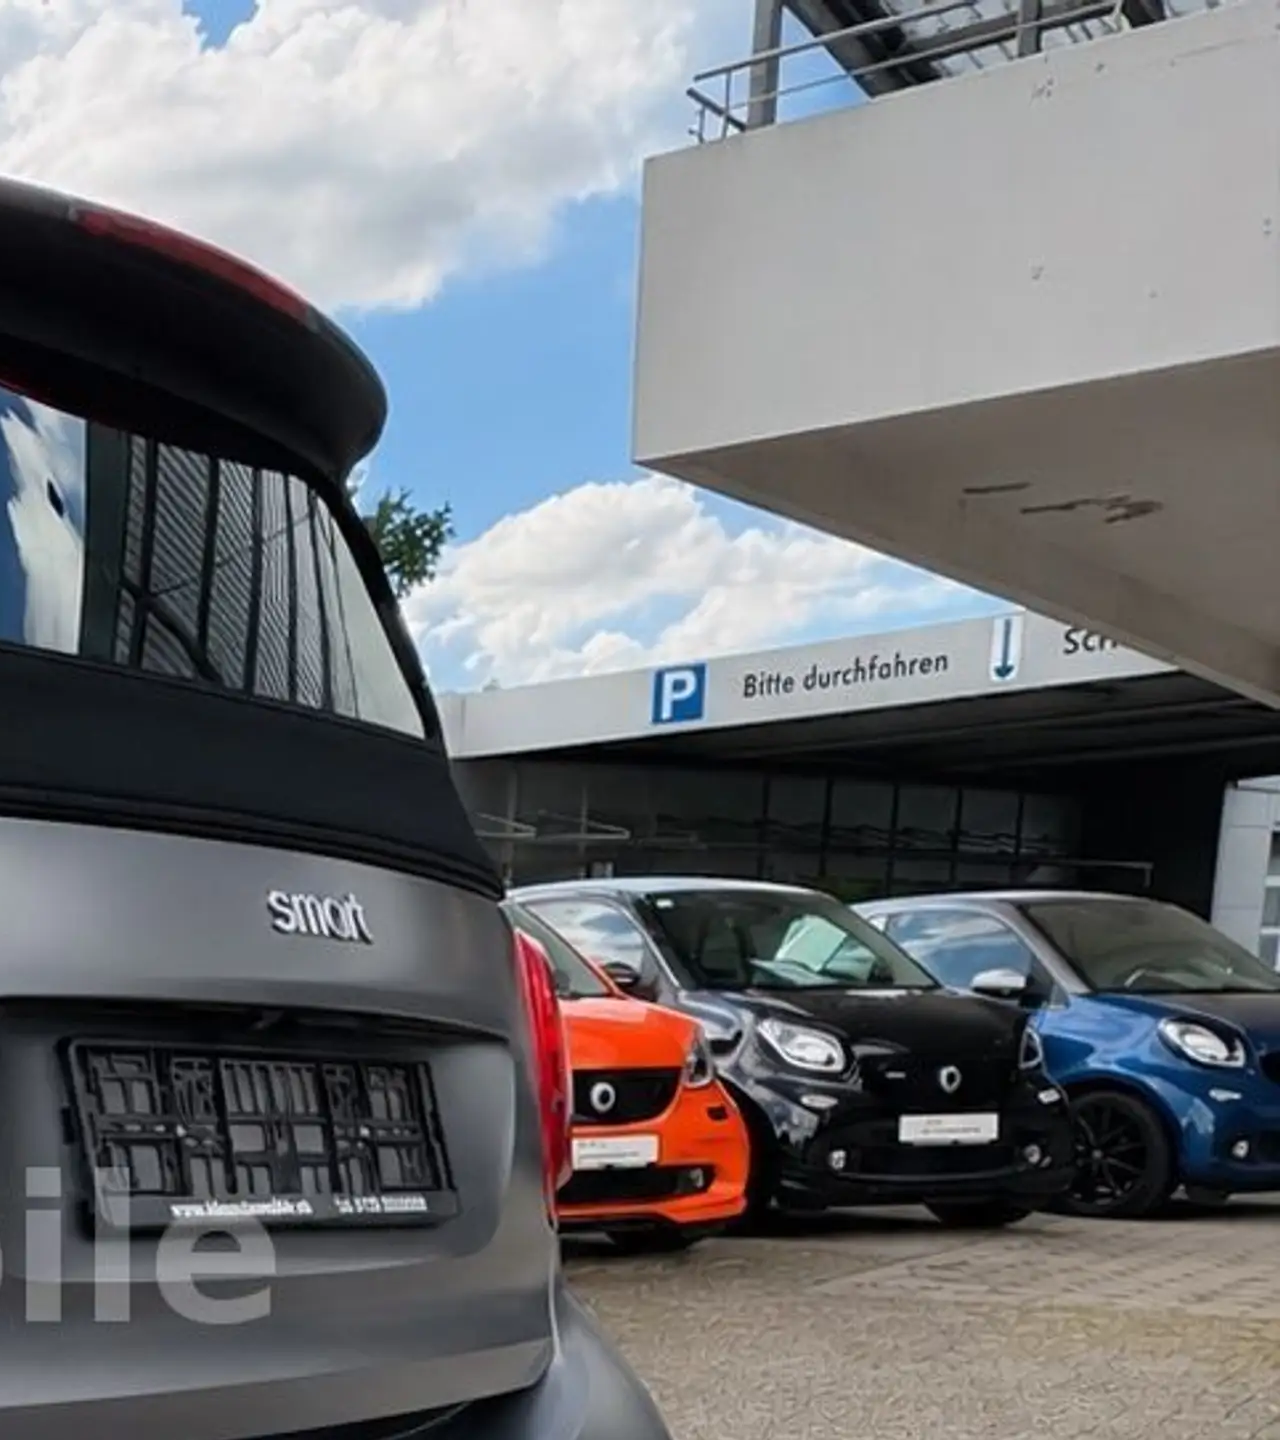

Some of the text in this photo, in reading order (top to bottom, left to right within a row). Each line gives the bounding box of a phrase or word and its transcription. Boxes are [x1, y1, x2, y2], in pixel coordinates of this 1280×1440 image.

[661, 669, 696, 720] P
[743, 653, 949, 699] Bitte durchfahren
[267, 889, 374, 943] smart
